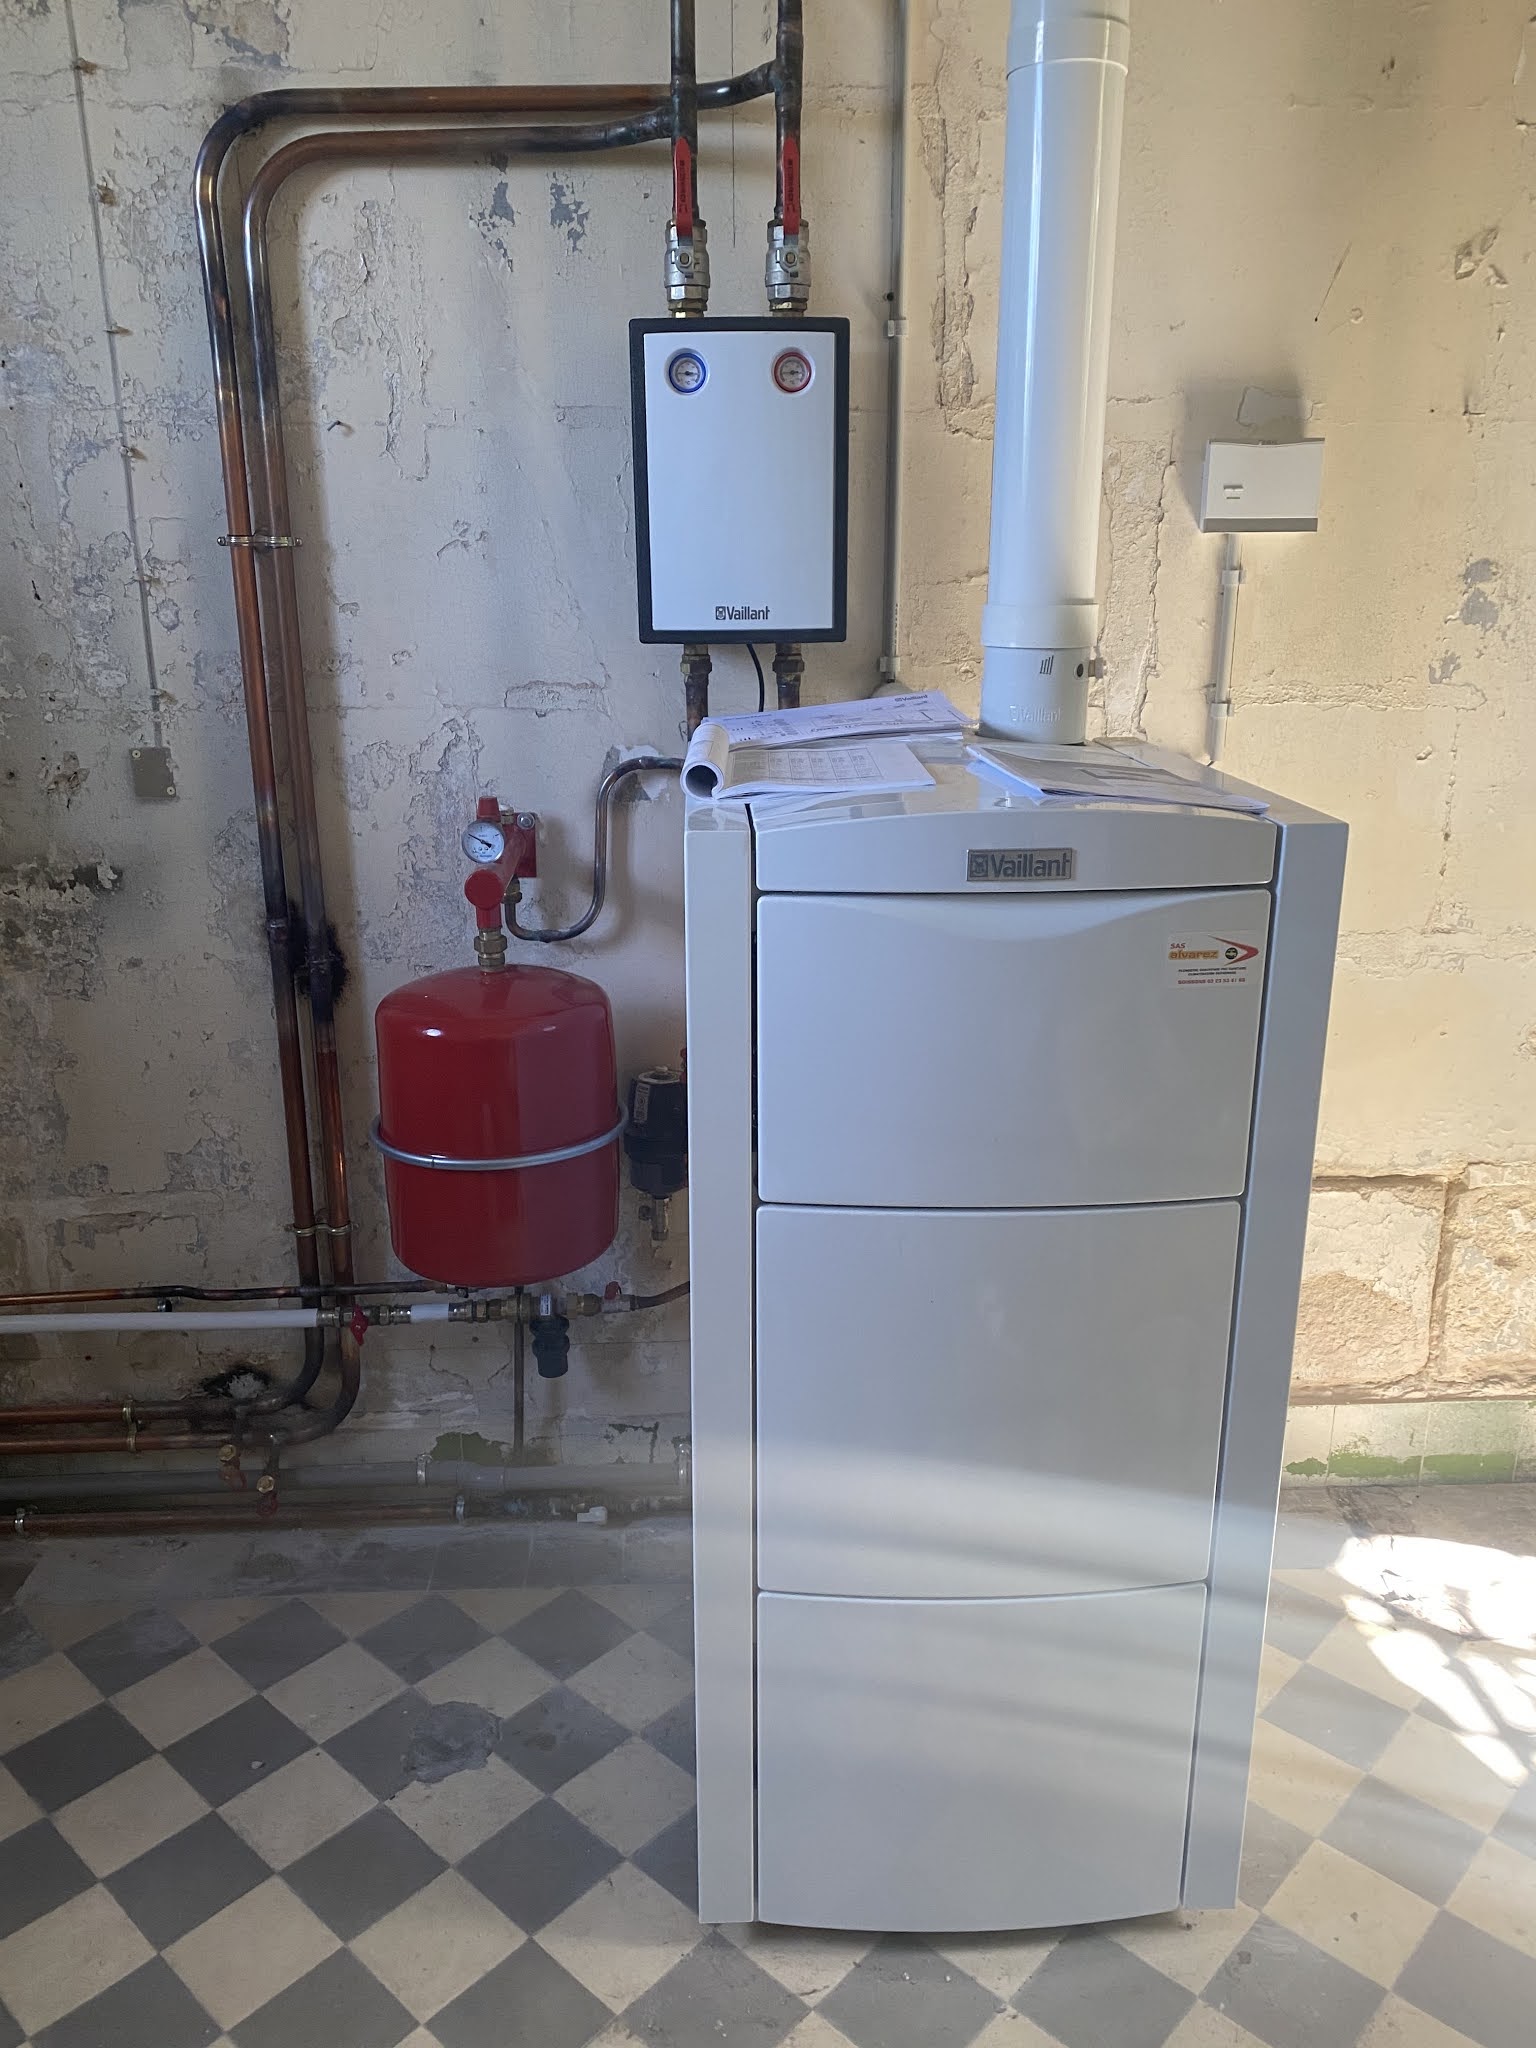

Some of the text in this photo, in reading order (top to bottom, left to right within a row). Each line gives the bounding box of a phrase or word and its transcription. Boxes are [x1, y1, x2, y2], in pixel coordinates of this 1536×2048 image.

[726, 605, 770, 620] Vaillant
[901, 694, 928, 702] Vaillant
[1020, 706, 1061, 722] Vaillant
[991, 852, 1071, 878] Vaillant
[1170, 942, 1186, 950] SAS
[1169, 949, 1219, 960] alvarez
